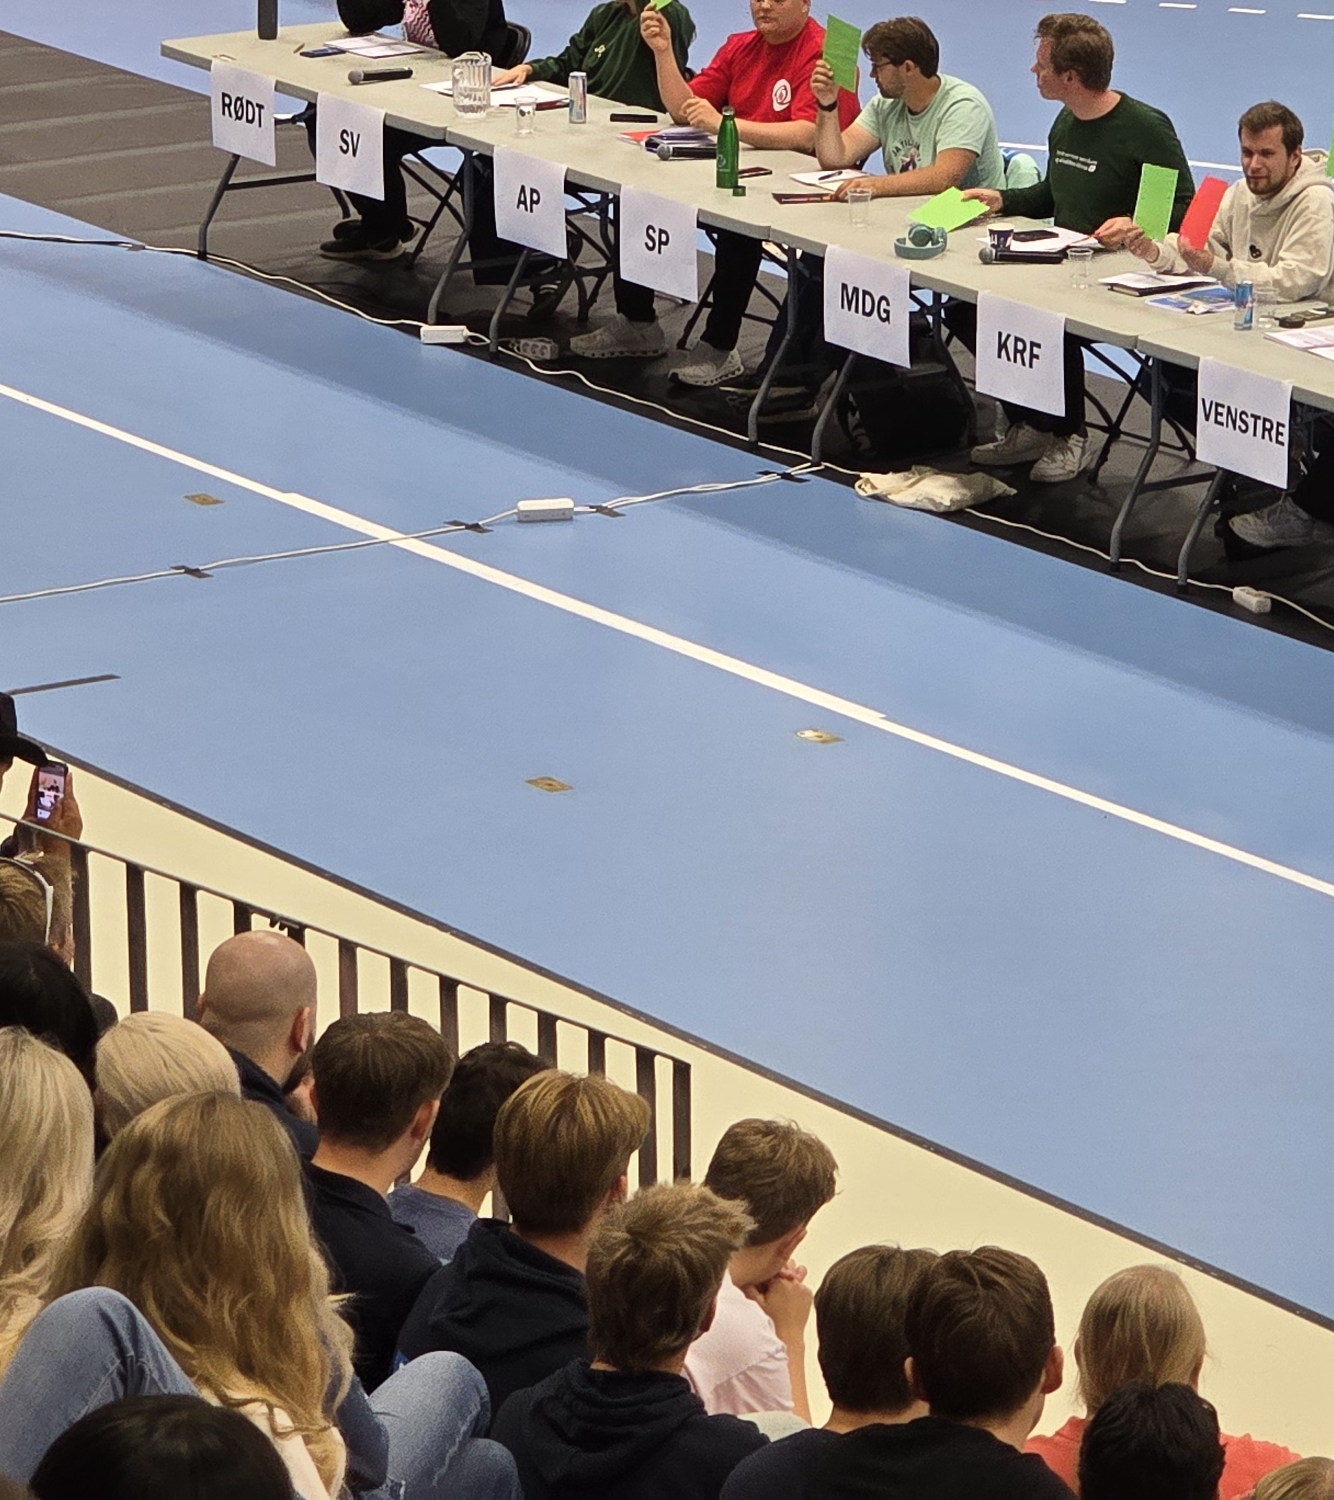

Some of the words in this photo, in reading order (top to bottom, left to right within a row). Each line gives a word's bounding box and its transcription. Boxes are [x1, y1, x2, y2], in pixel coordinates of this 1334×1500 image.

[221, 91, 266, 129] RØDT
[338, 128, 361, 158] SV
[516, 184, 541, 214] AP
[644, 224, 670, 255] SP
[840, 282, 891, 325] MDG
[997, 330, 1042, 369] KRF
[1201, 397, 1286, 447] VENSTRE
